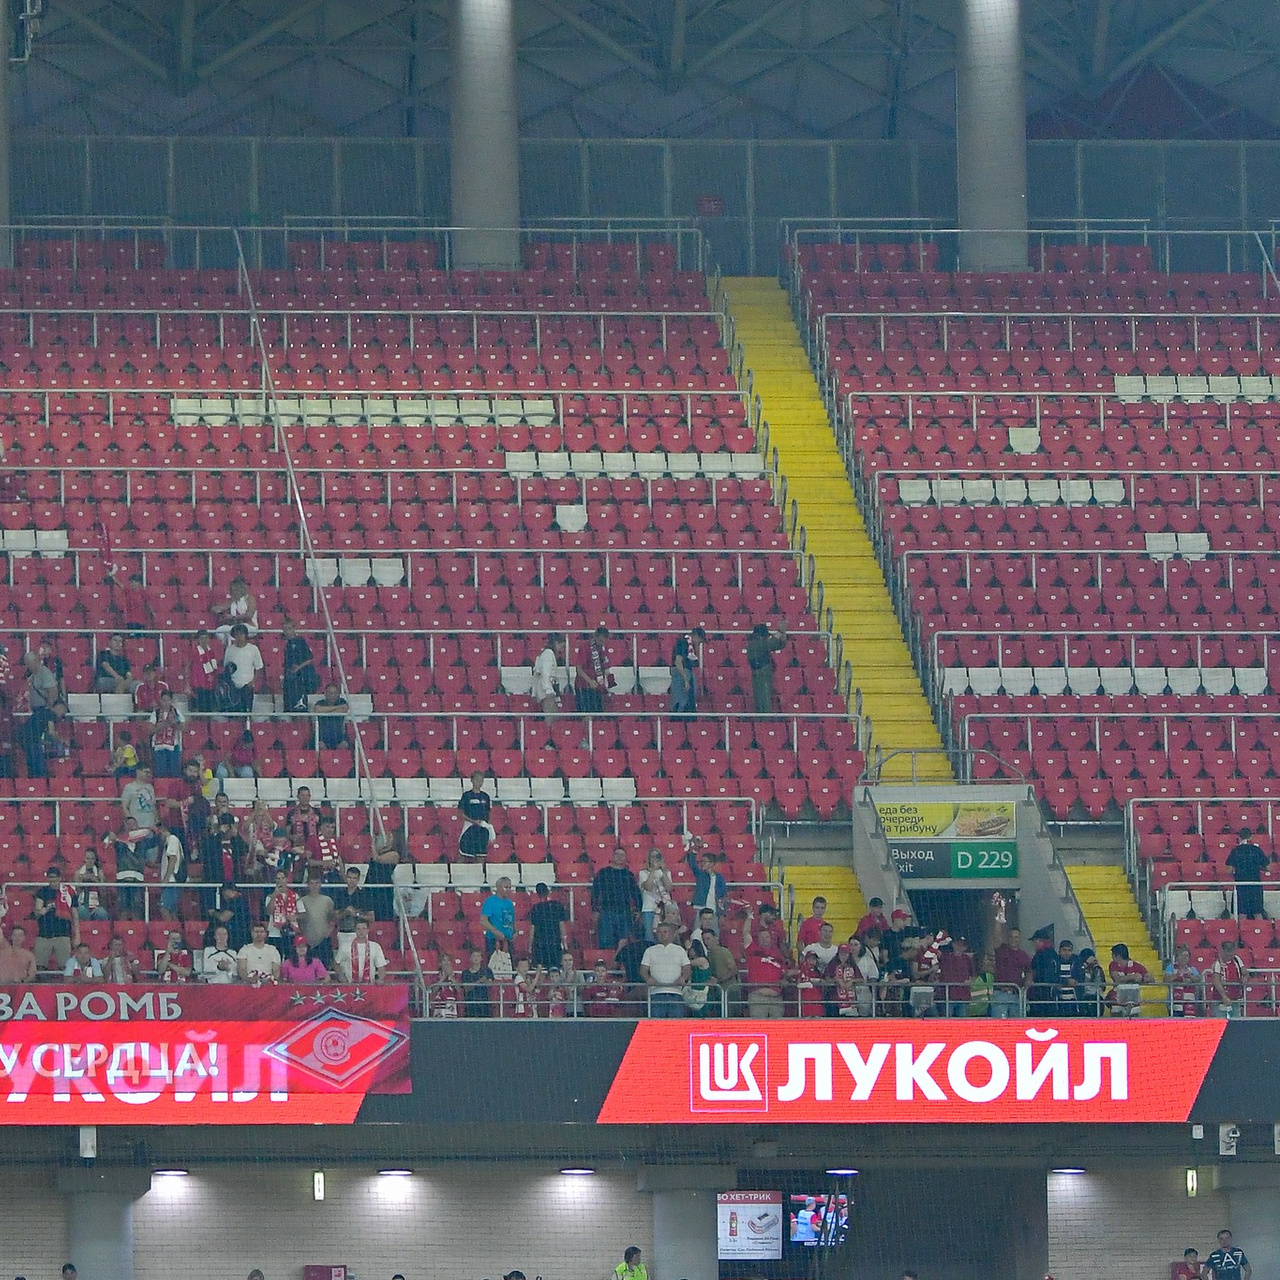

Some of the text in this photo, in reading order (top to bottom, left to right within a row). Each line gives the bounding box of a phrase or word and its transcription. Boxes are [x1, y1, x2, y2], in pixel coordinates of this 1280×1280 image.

[880, 805, 918, 815] еда без
[894, 824, 938, 834] трибуну
[891, 849, 935, 861] Выход
[957, 851, 1013, 869] D 229
[55, 991, 183, 1021] РОМБ
[31, 1041, 220, 1084] СЕРДЦА!
[776, 1028, 1130, 1103] ЛУКОЙЛ
[730, 1193, 771, 1201] ХЕТ-ТРИК
